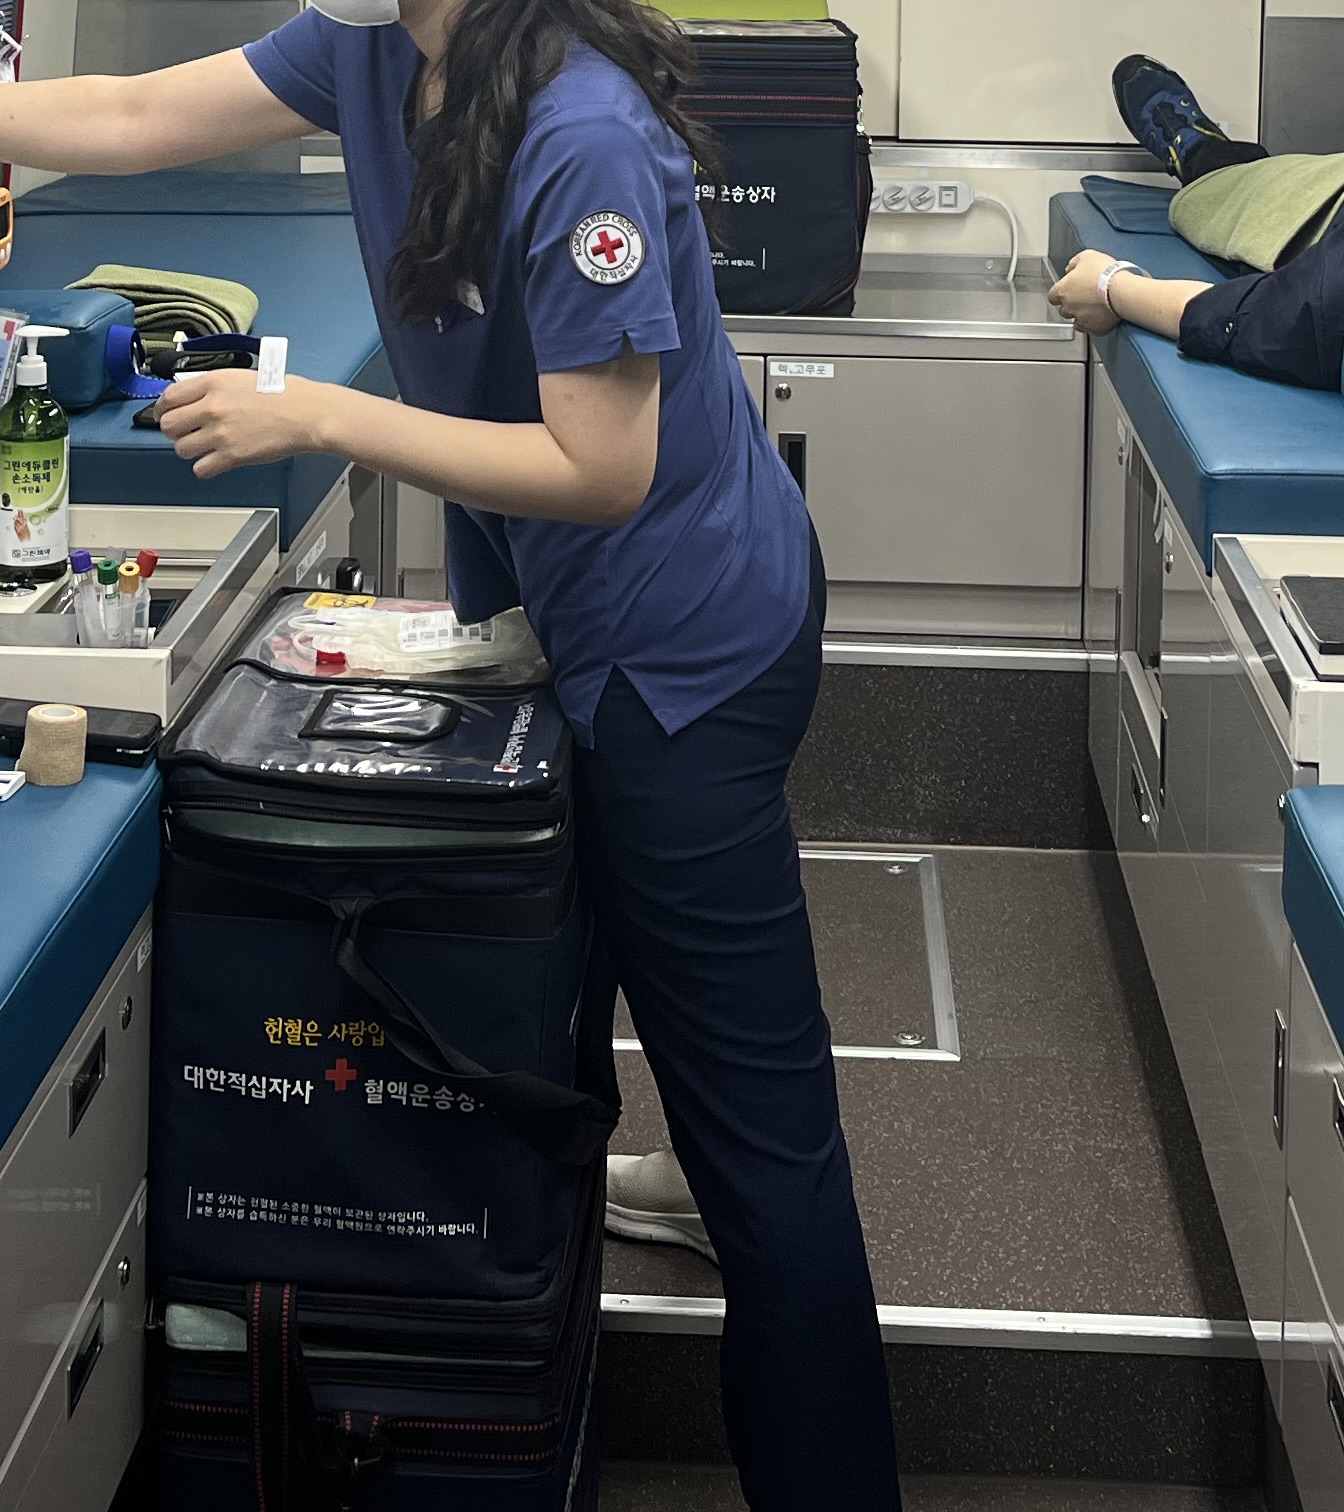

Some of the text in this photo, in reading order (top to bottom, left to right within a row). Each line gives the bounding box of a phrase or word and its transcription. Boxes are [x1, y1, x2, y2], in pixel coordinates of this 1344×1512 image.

[573, 213, 638, 257] KOREAN RED CROSS
[12, 472, 51, 484] 손소독제
[264, 1017, 386, 1048] 헌혈은 사랑입
[184, 1065, 315, 1105] 대한적십자사
[364, 1078, 486, 1113] 혈액운송상
[218, 1193, 246, 1206] 상자는
[438, 1223, 479, 1236] 바랍니다.
